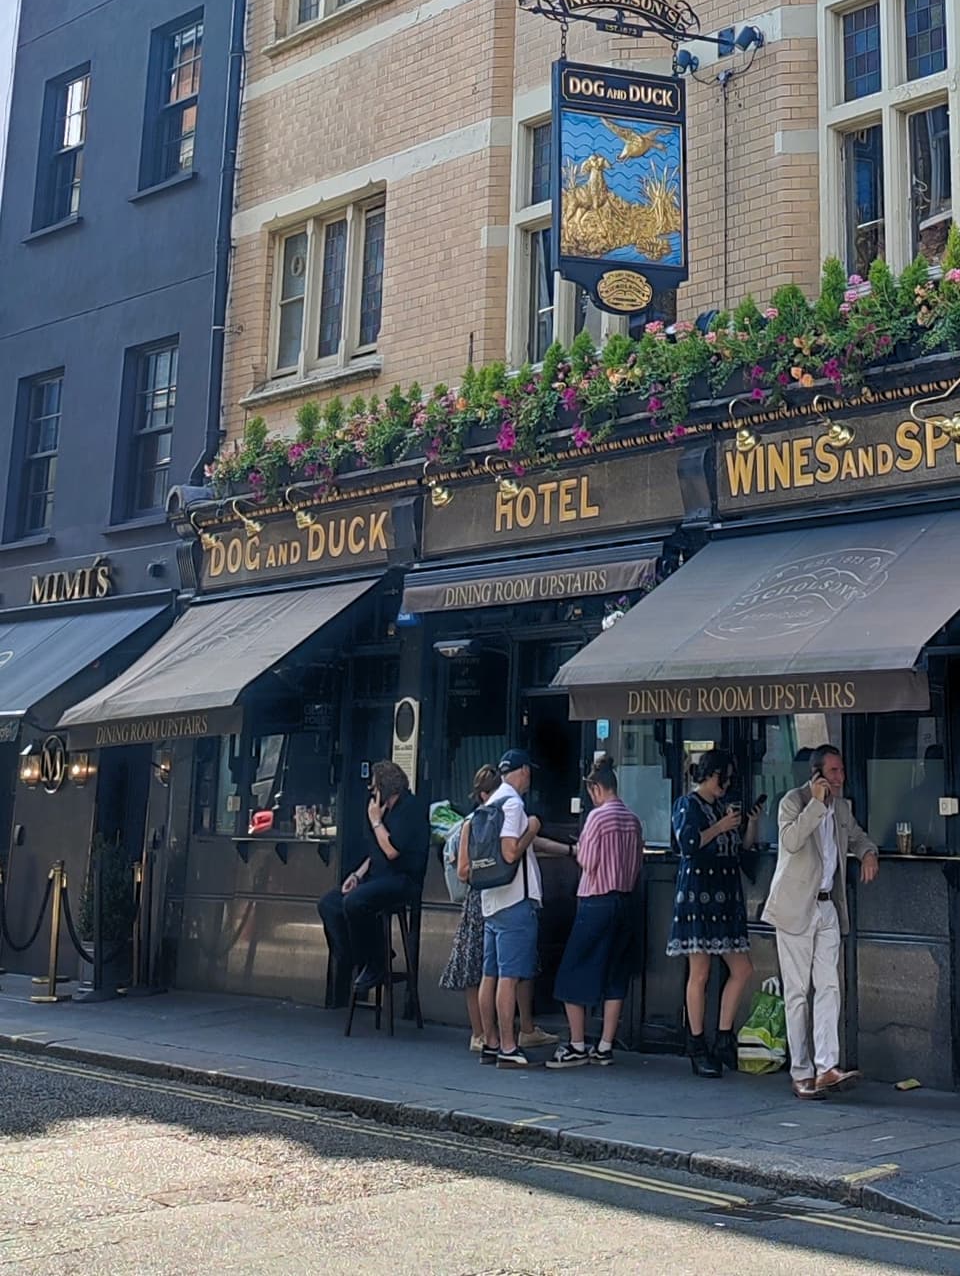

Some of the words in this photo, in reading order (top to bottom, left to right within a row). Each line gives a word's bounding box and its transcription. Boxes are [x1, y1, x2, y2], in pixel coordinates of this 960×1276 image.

[569, 76, 605, 97] DOG
[606, 88, 627, 101] AND
[629, 84, 673, 107] DUCK
[726, 433, 840, 497] WINES
[840, 442, 894, 480] AND
[494, 475, 599, 532] HOTEL
[209, 537, 261, 577] DOG
[265, 541, 300, 568] AND
[307, 510, 389, 562] DUCK
[444, 583, 491, 607] DINING
[494, 579, 535, 602] ROOM
[539, 569, 607, 597] UPSTAIRS
[627, 687, 692, 715] DINING
[697, 685, 755, 713] ROOM
[759, 681, 856, 710] UPSTAIRS
[95, 724, 130, 745] DINING
[130, 720, 160, 742] ROOM
[160, 715, 208, 738] UPSTAIRS
[43, 750, 61, 782] M
